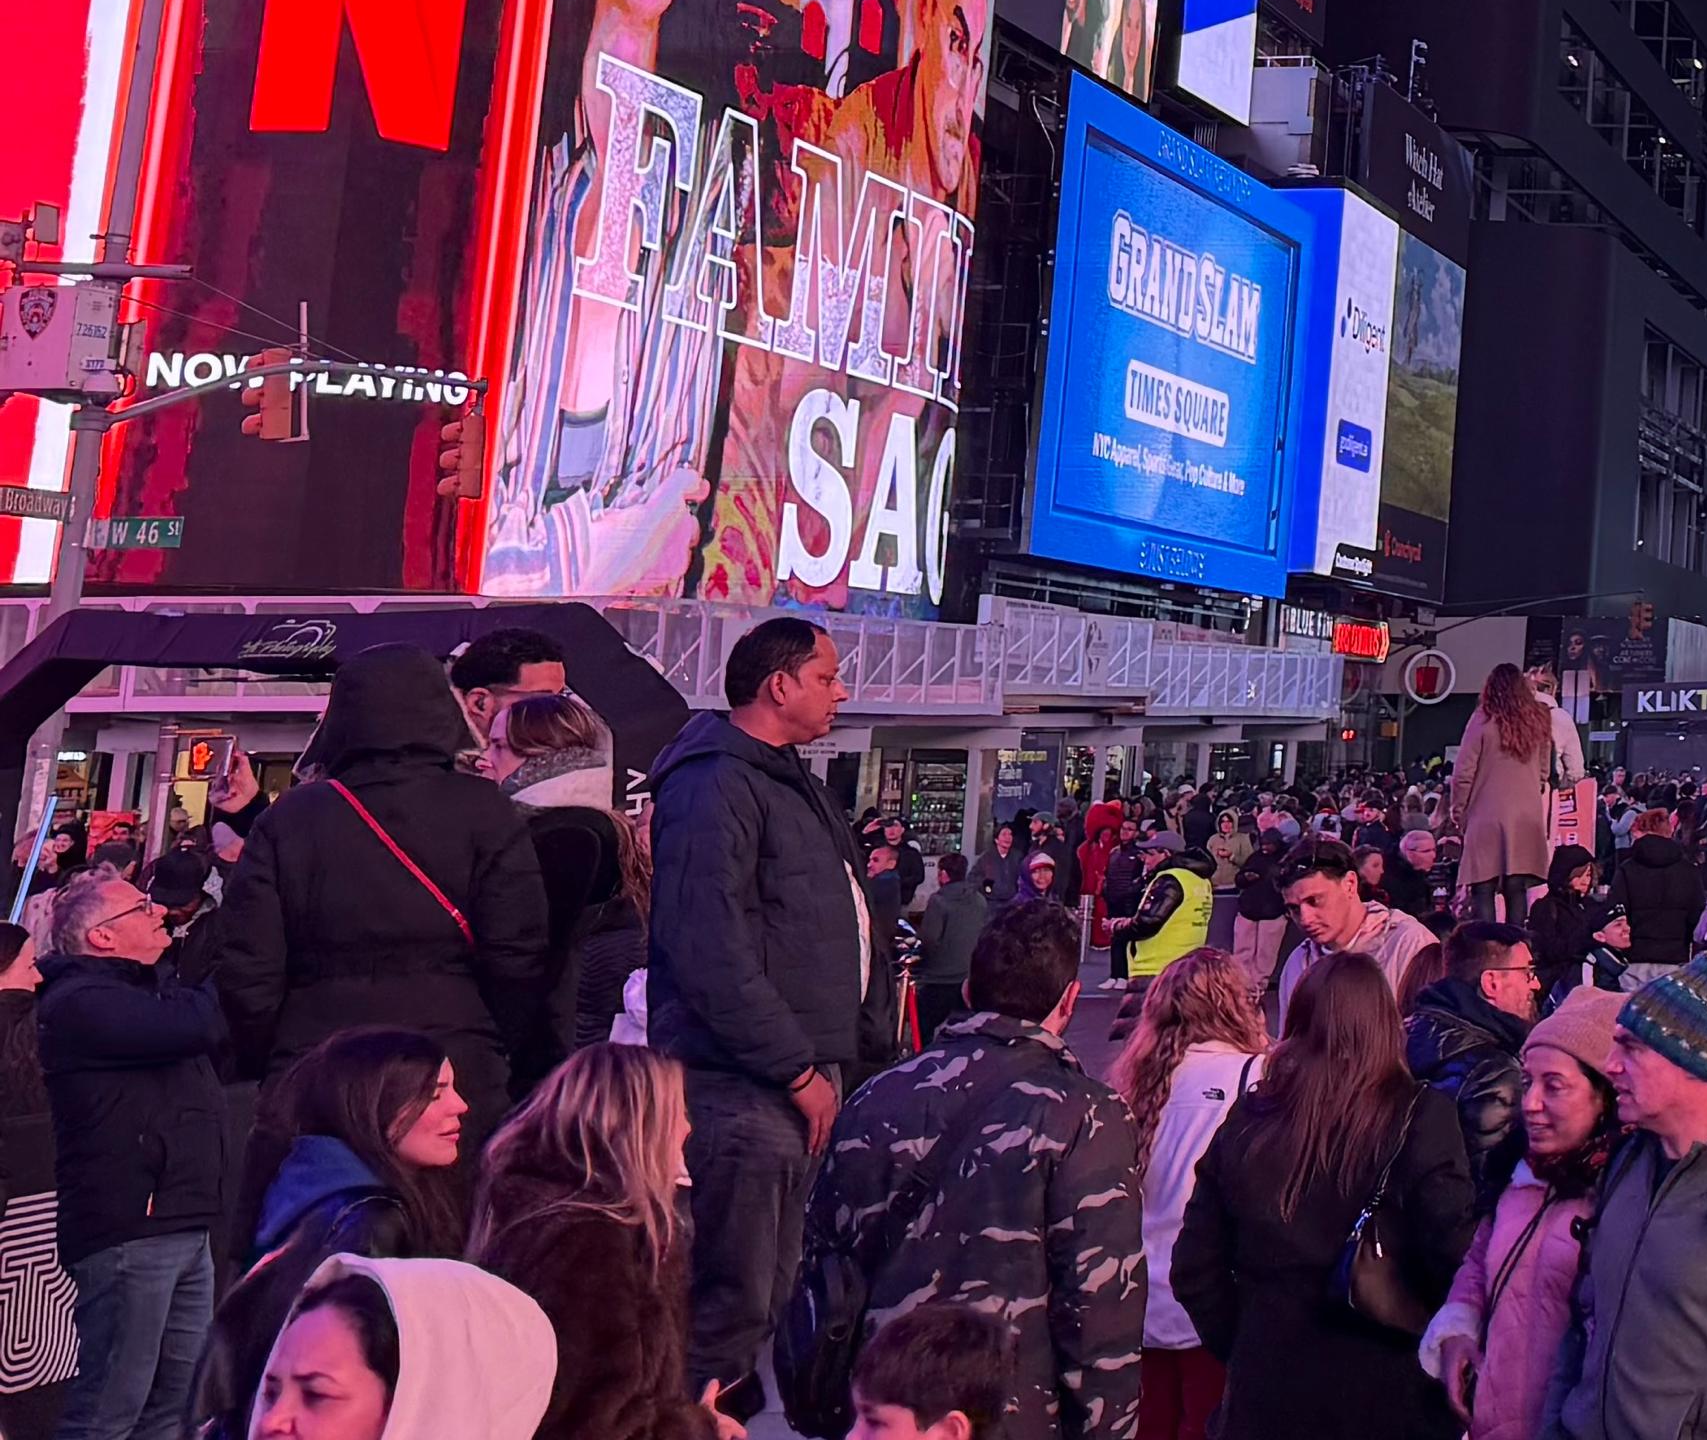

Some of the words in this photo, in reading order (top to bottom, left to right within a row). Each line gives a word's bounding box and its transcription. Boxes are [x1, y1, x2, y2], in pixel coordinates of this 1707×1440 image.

[1108, 209, 1198, 337] GRAND
[1196, 252, 1261, 364] SLAM
[1130, 369, 1172, 420] TIMES
[1174, 386, 1227, 438] SQUARE
[3, 490, 70, 517] Broadway
[111, 521, 129, 543] W
[135, 521, 160, 545] 46
[166, 518, 182, 538] St
